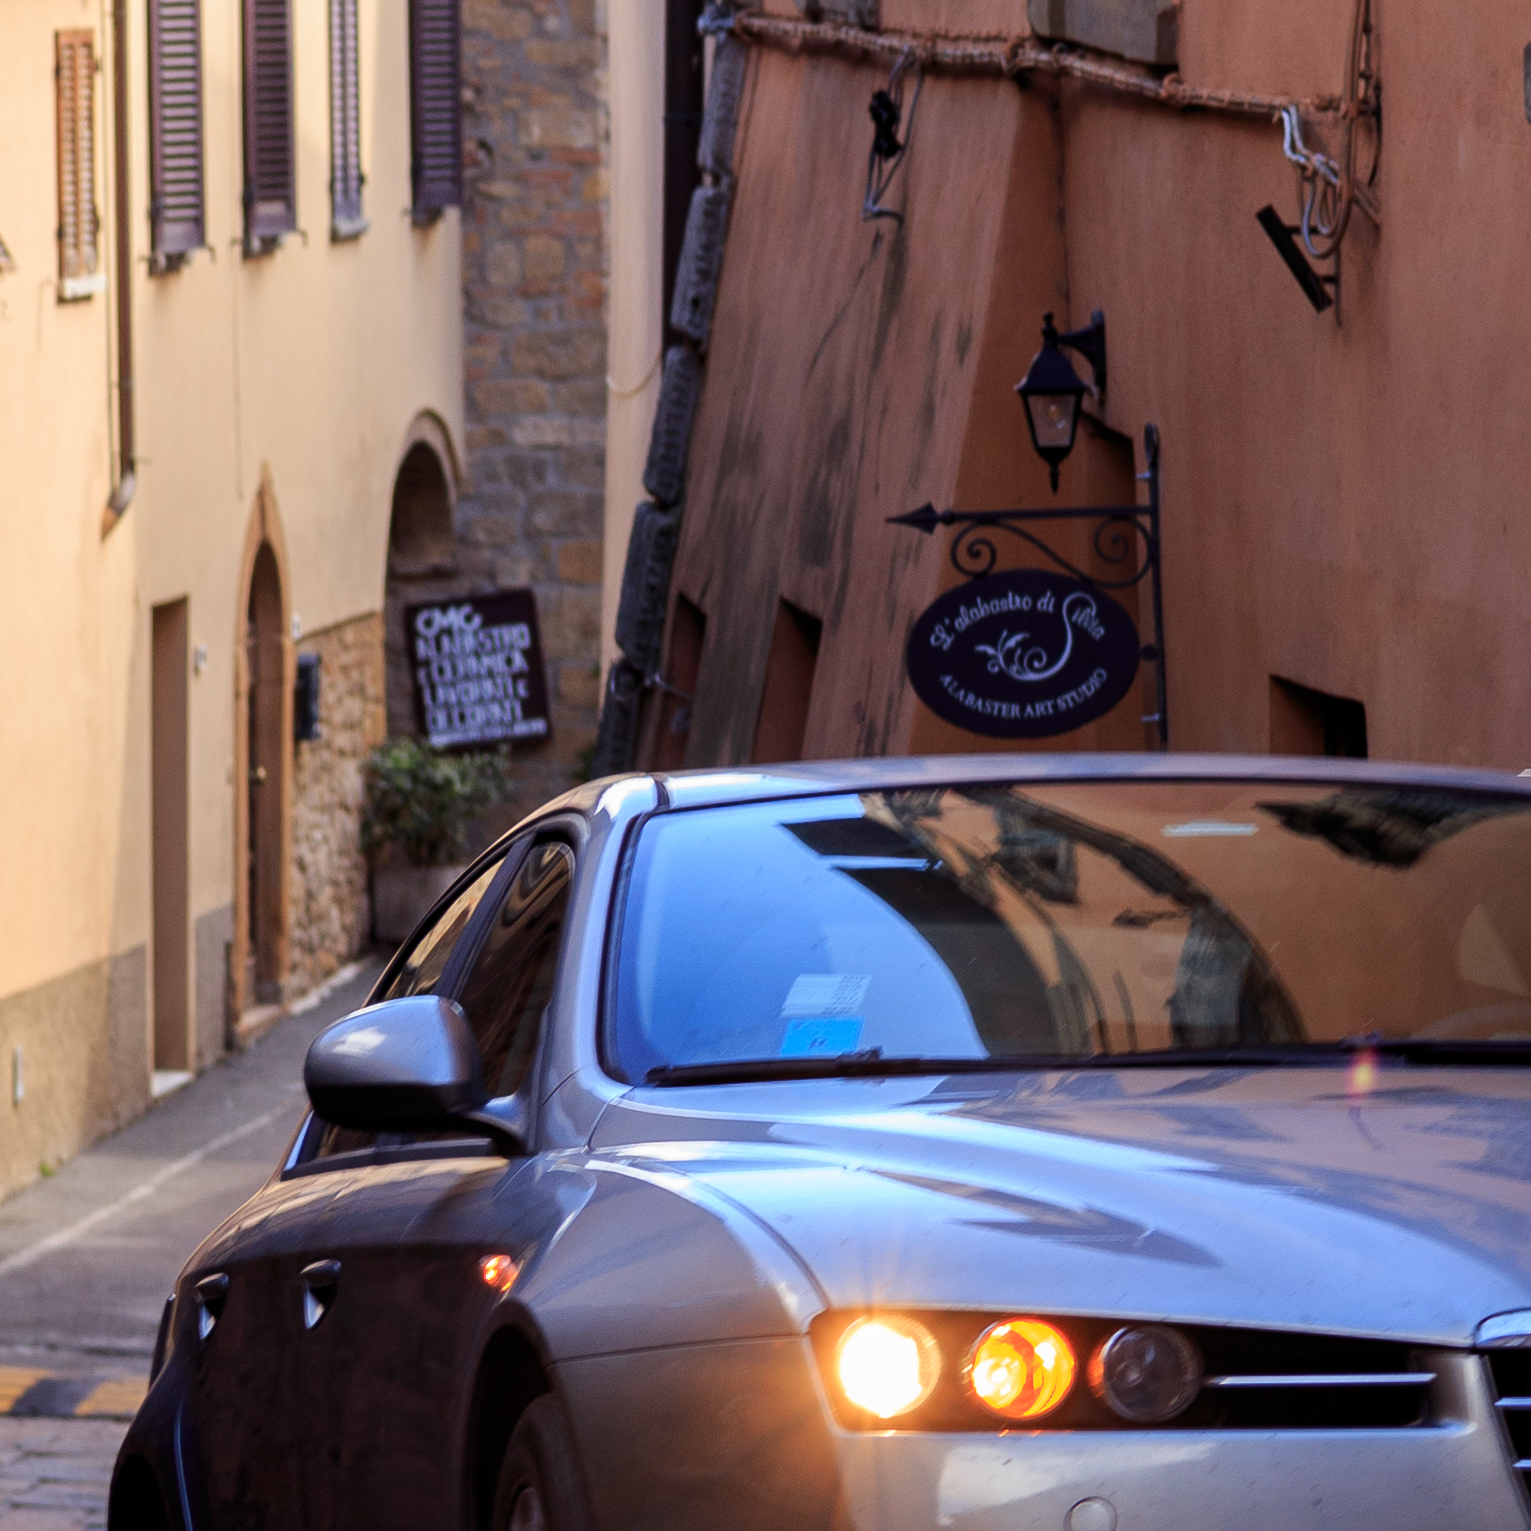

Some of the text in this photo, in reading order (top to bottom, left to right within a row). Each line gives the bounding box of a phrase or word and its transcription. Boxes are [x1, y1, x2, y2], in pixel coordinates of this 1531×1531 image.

[1037, 590, 1055, 614] di
[940, 668, 1107, 719] ALABASTER ART STUDIO
